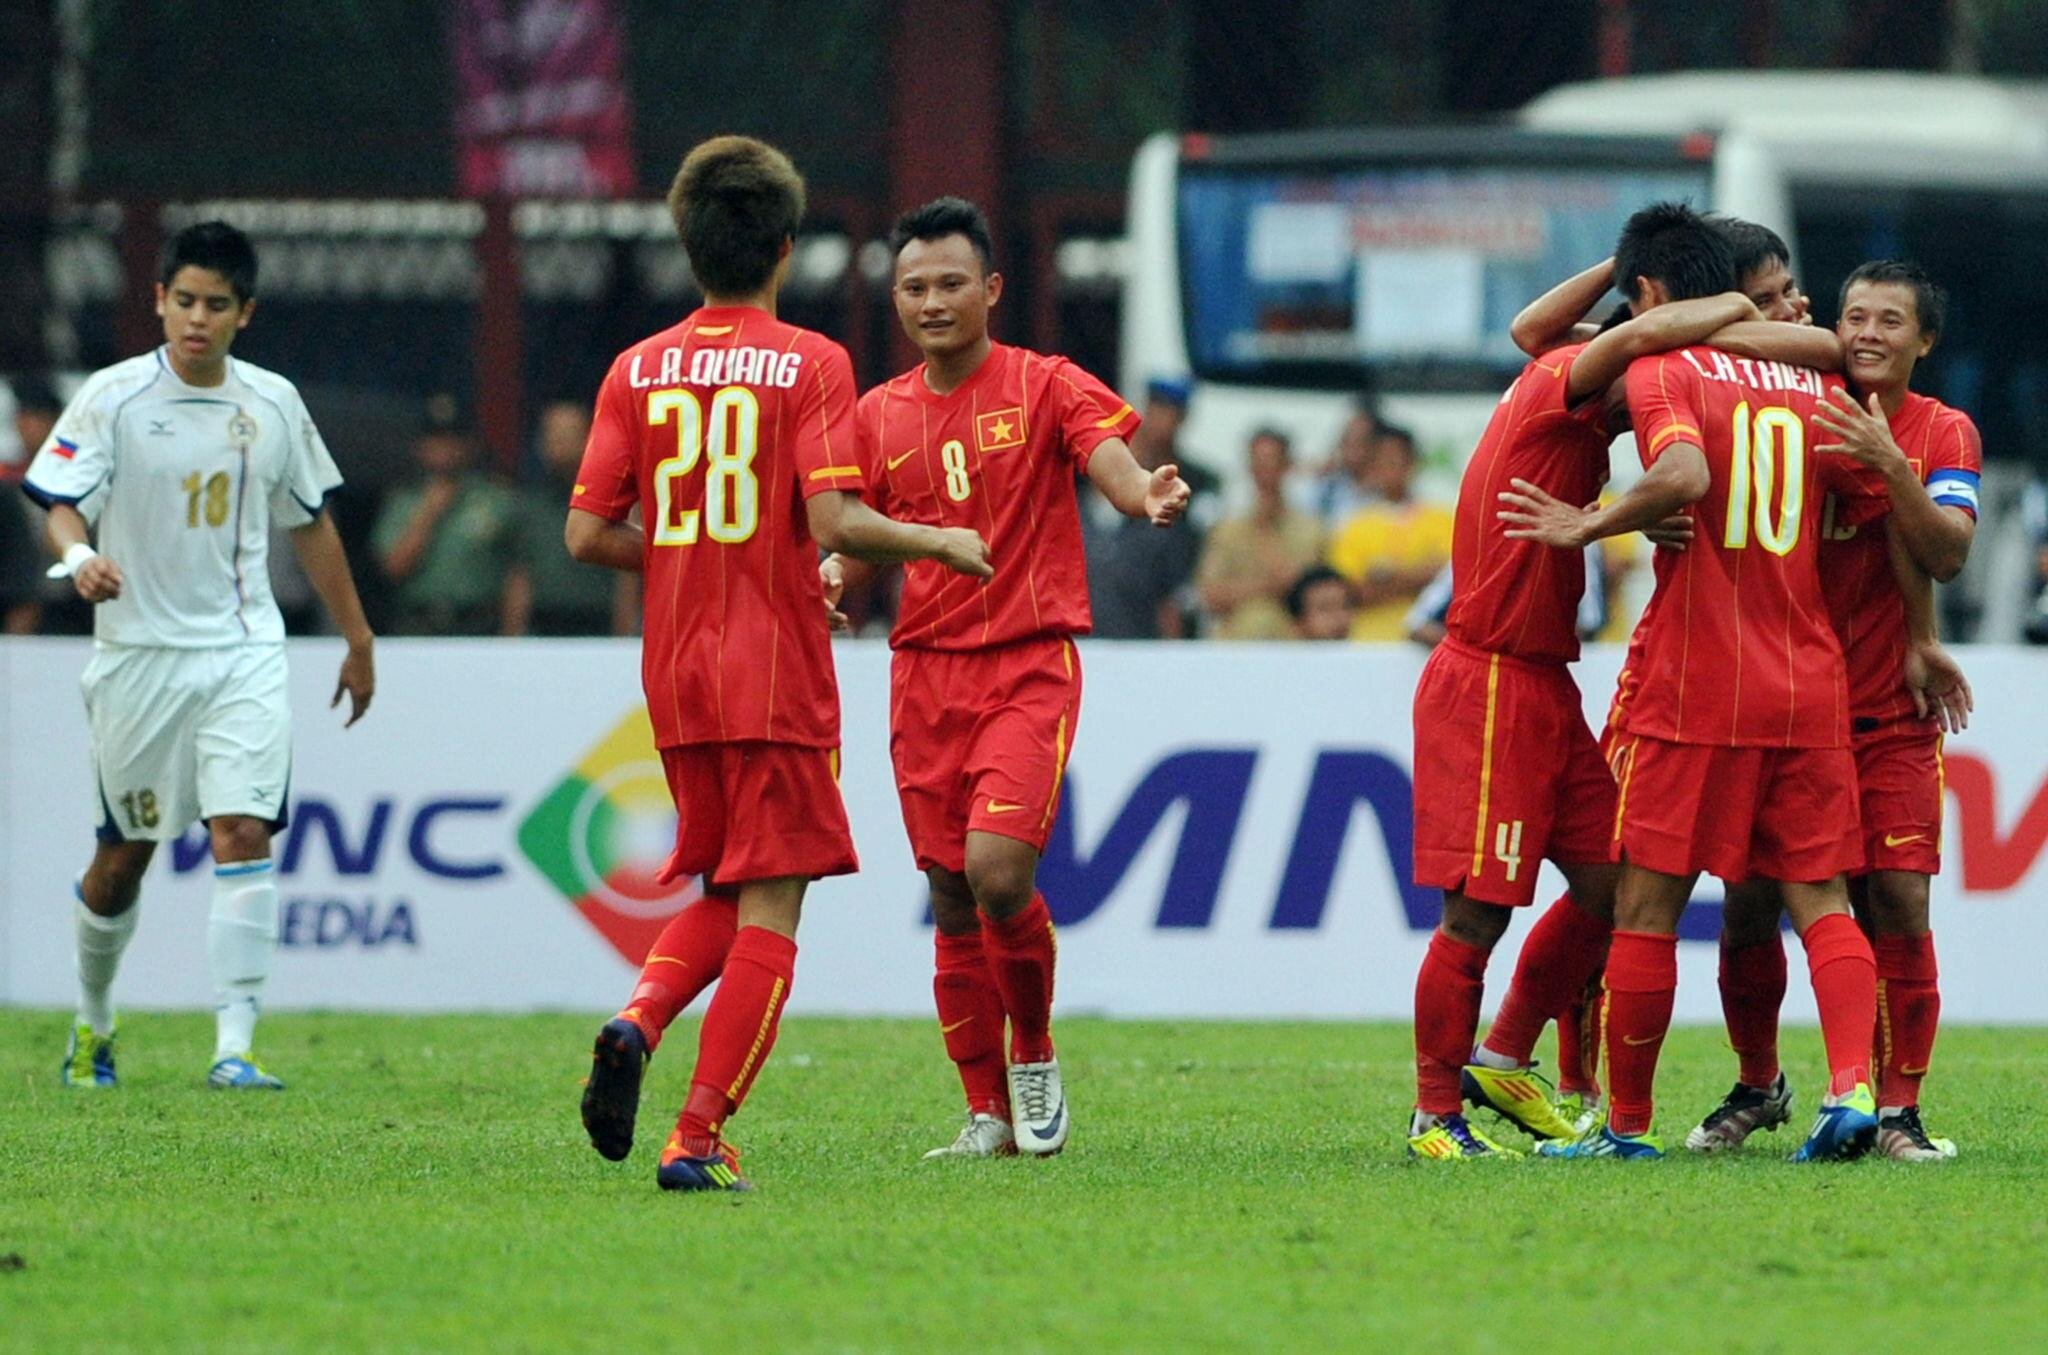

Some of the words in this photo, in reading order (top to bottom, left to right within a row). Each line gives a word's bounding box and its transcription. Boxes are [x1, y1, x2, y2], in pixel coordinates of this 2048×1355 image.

[629, 346, 802, 388] L.A.QUANG
[648, 386, 759, 546] 28
[941, 439, 971, 501] 8
[1723, 400, 1804, 557] 10
[181, 470, 230, 528] 18
[119, 789, 160, 829] 18
[1495, 820, 1521, 881] 4
